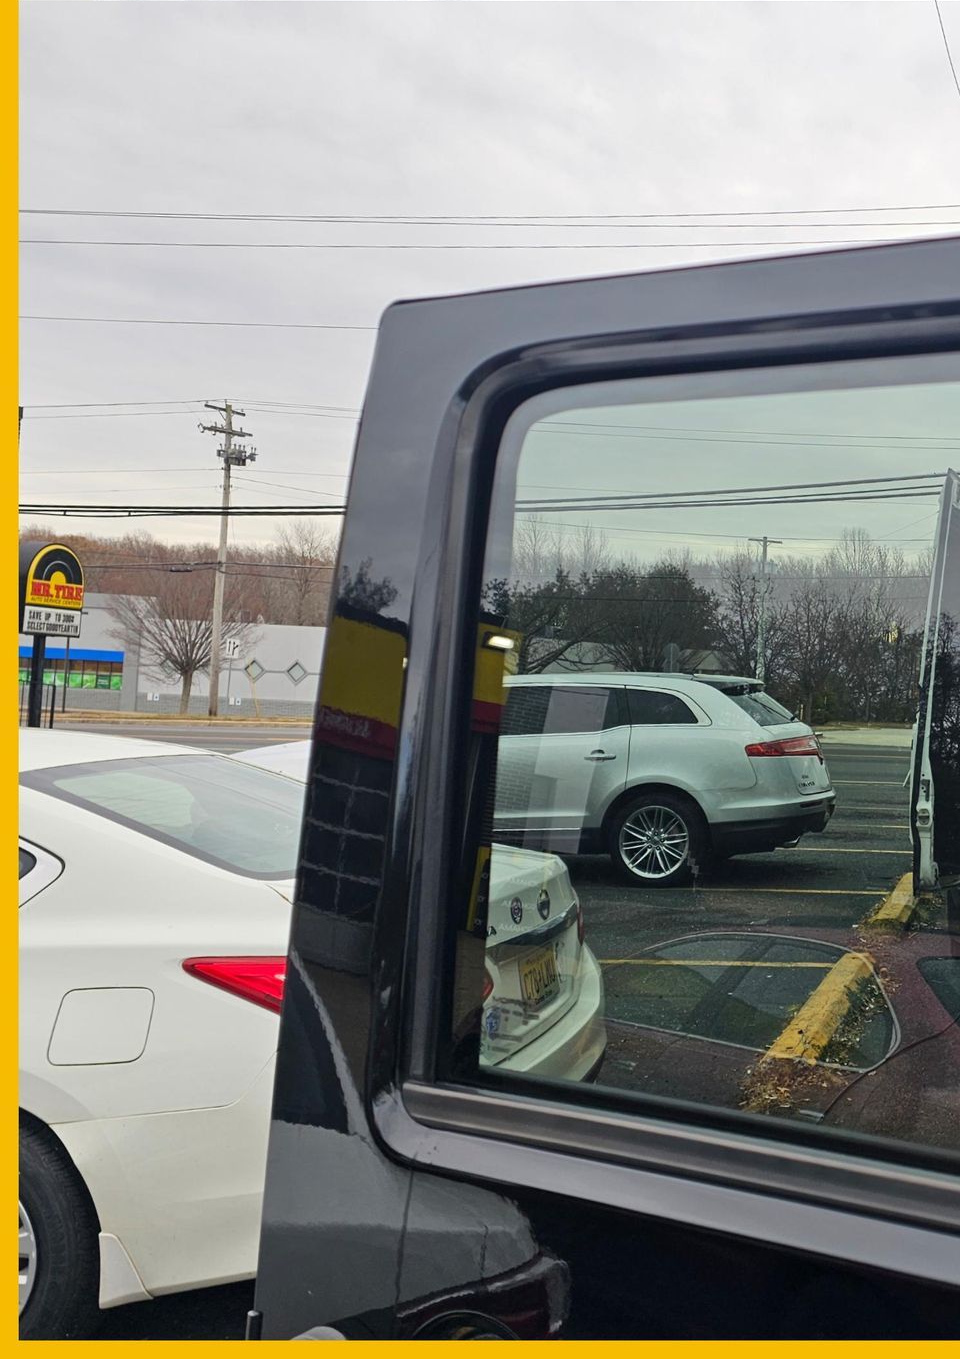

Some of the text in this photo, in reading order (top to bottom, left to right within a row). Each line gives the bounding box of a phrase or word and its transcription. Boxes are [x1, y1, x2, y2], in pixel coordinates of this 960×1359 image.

[31, 581, 82, 601] MR. TIRE
[28, 611, 42, 621] SAVE
[44, 612, 51, 621] UP
[55, 613, 61, 622] TO
